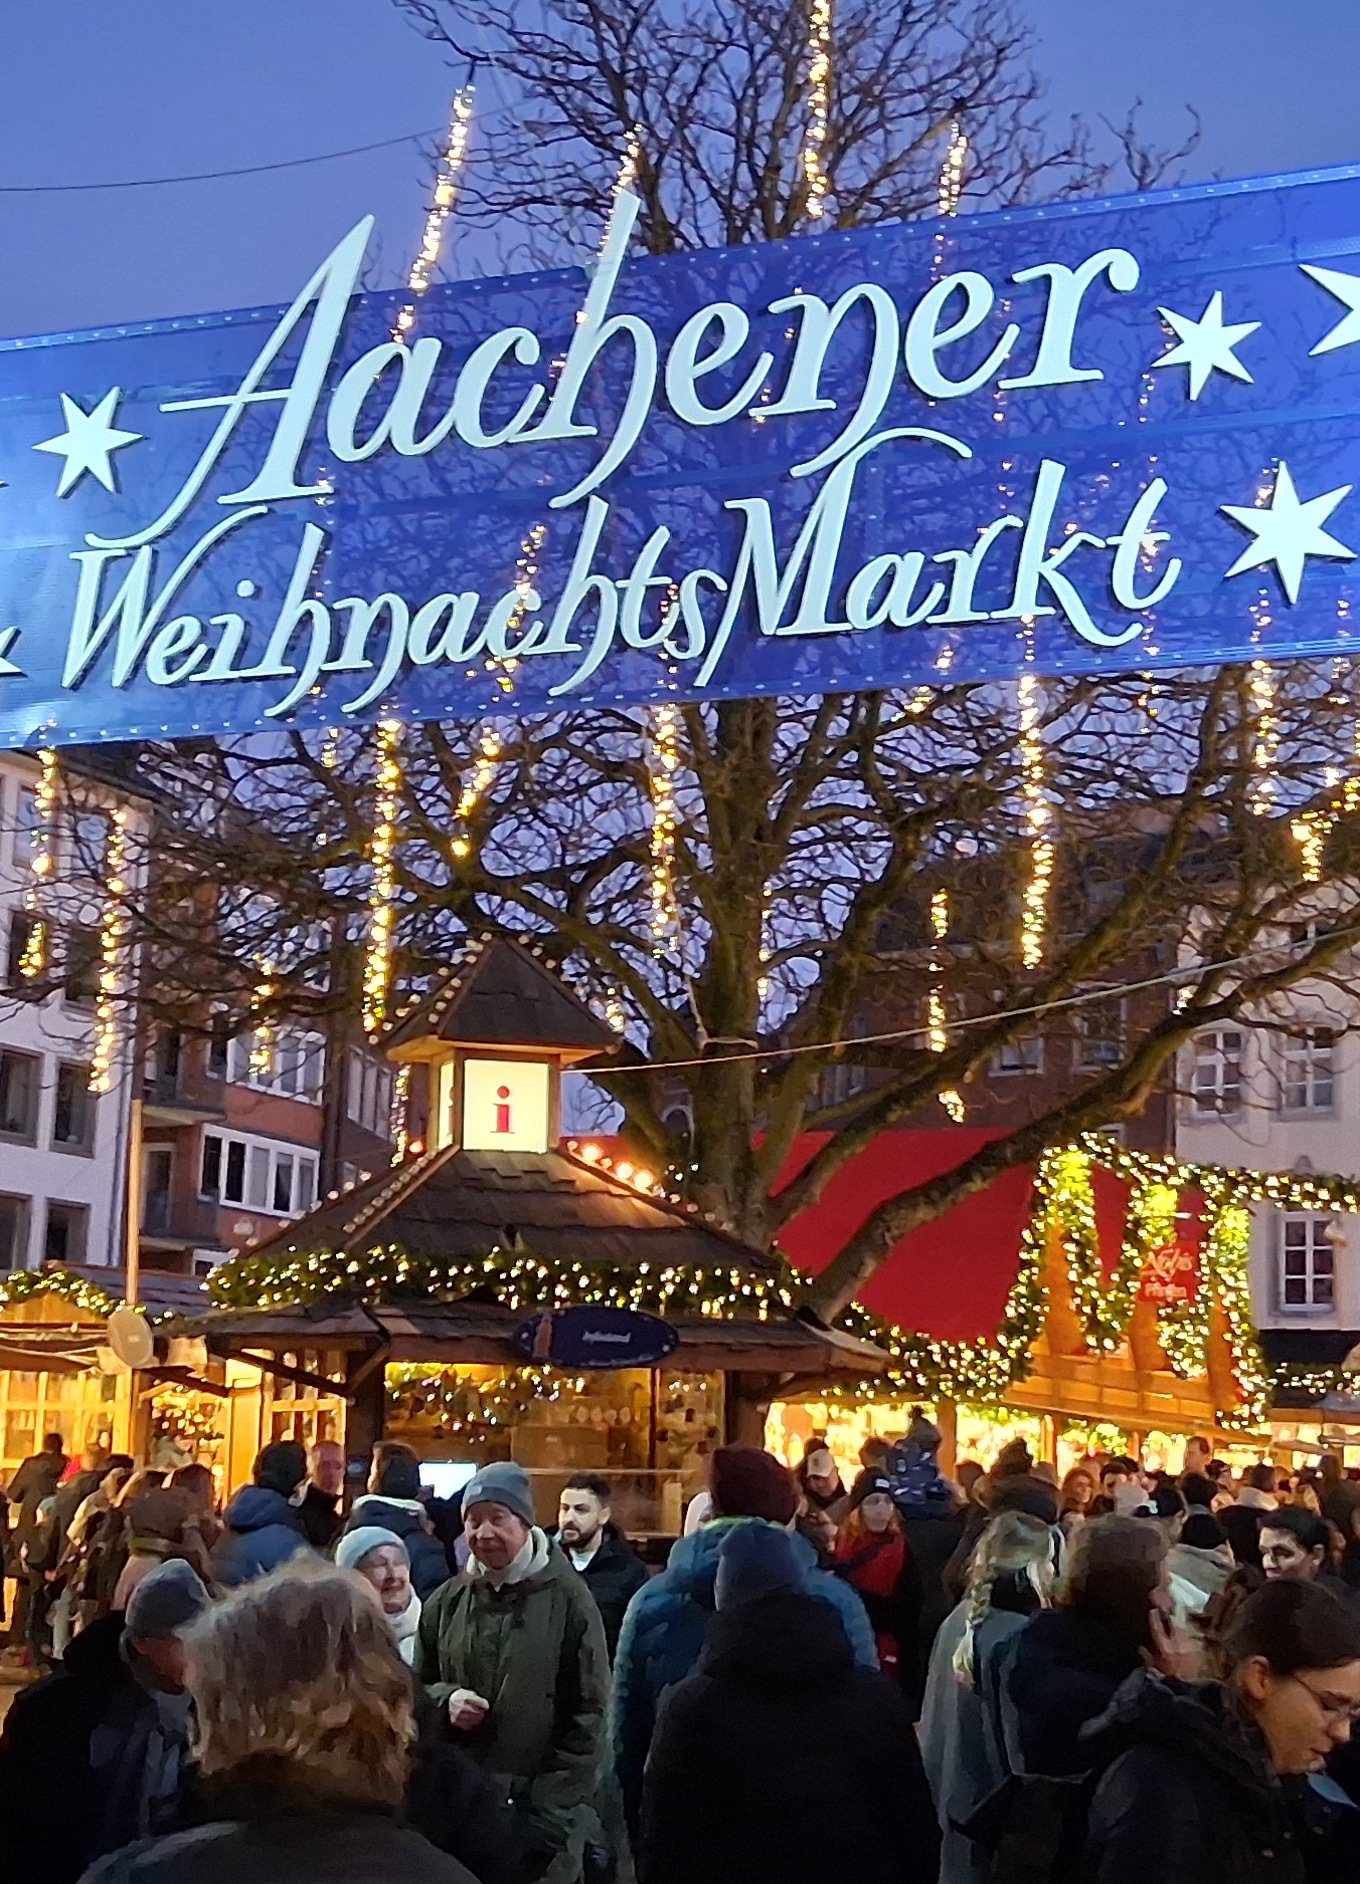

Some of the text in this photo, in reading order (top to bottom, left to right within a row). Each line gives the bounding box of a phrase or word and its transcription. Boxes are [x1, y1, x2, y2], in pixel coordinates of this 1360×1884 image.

[84, 192, 1140, 546] Aachener
[60, 427, 1183, 716] WeihnachtsMarkt
[490, 1085, 516, 1134] i
